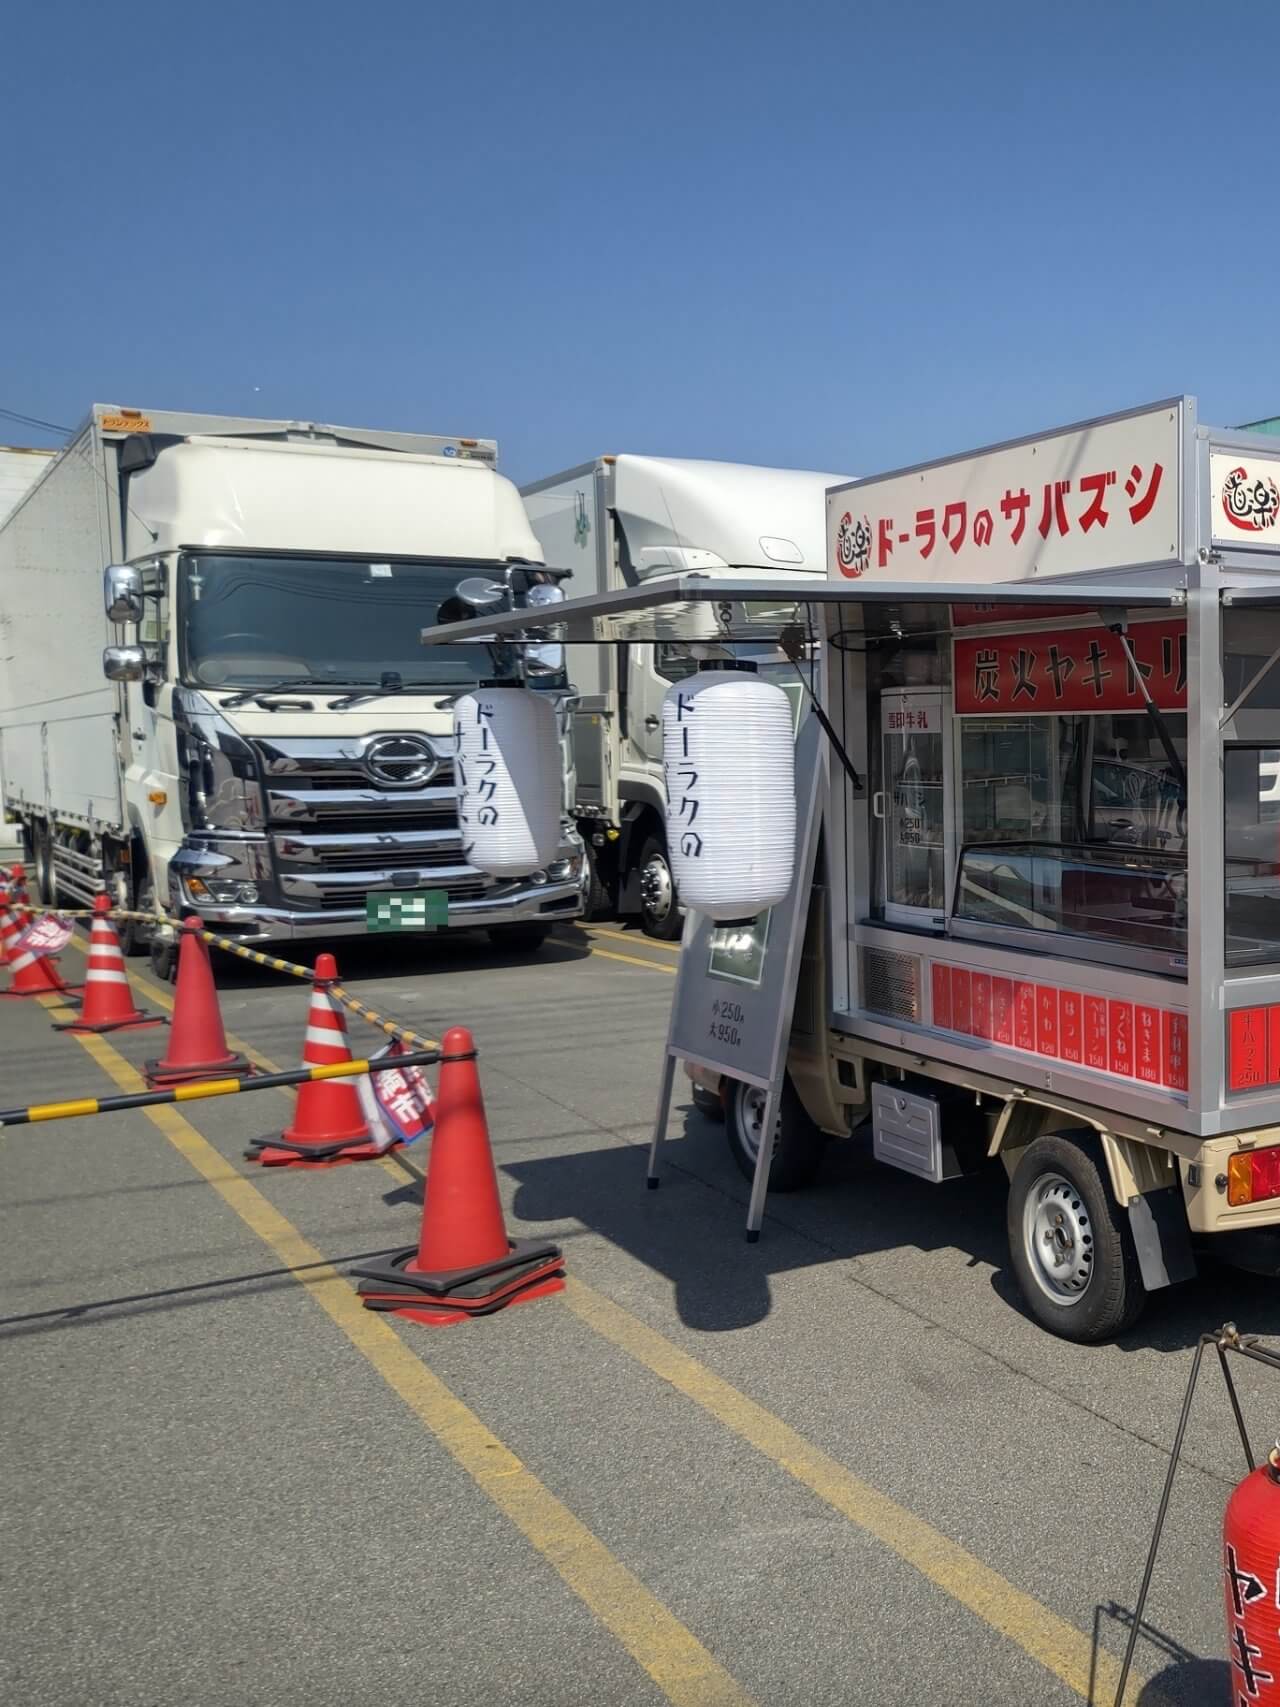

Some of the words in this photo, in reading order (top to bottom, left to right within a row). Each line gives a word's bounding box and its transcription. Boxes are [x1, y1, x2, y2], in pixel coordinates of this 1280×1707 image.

[878, 462, 1164, 569] ドーラクのサバズシ
[974, 633, 1187, 703] 炭火ヤキトリ
[476, 703, 498, 826] ドーラクの
[677, 693, 703, 858] ドーラクの
[1225, 1542, 1274, 1707] ヤキ
